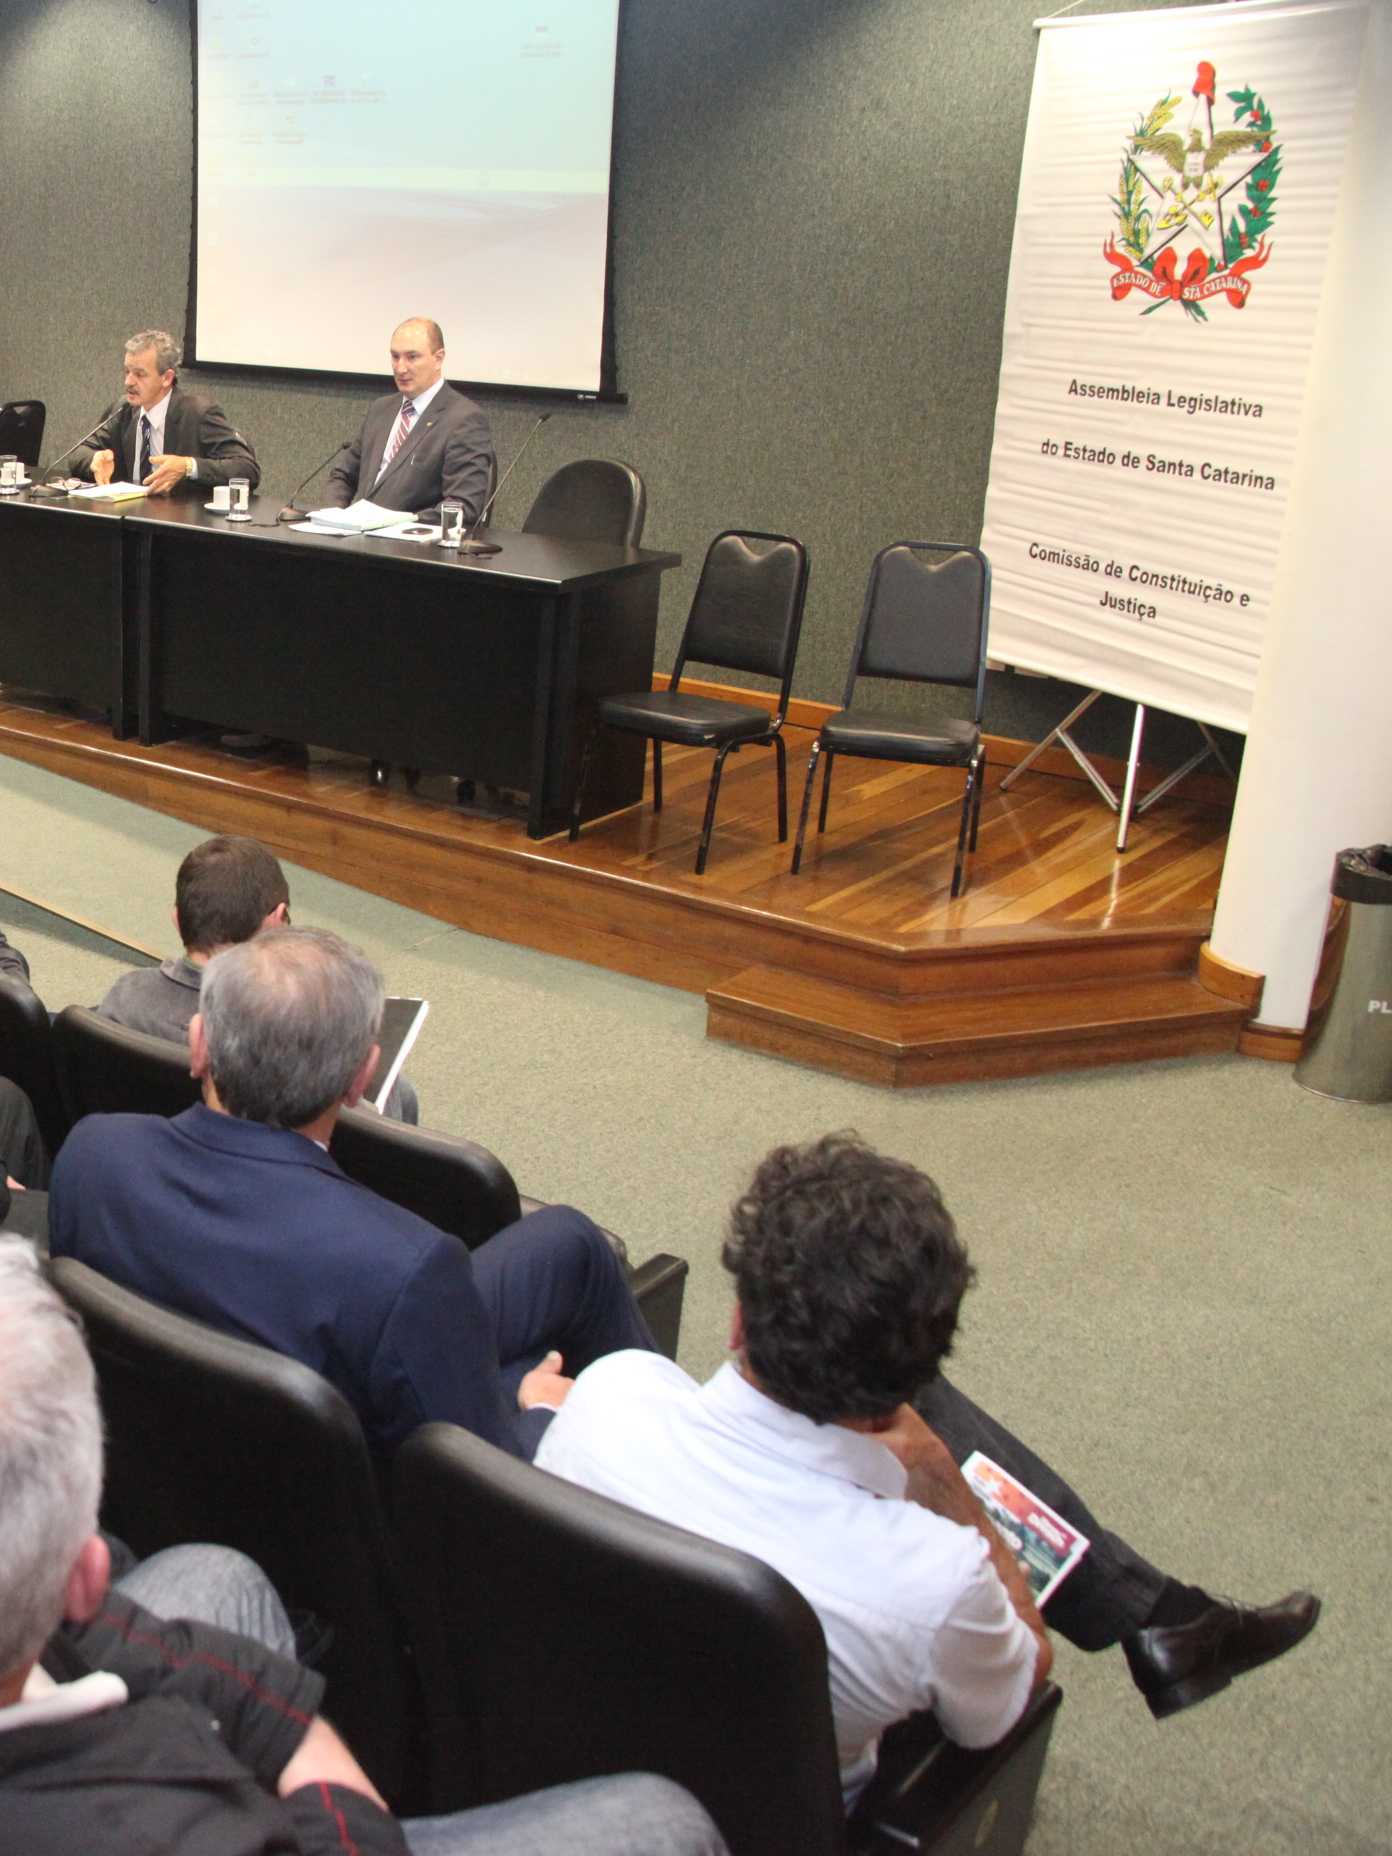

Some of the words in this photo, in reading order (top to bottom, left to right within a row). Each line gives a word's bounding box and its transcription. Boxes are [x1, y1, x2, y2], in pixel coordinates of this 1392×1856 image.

[1113, 272, 1149, 287] ESTADO
[1149, 282, 1163, 296] DE
[1203, 276, 1248, 294] CATARINA
[1068, 379, 1161, 405] Assembleia
[1166, 390, 1263, 418] Legislativa
[1041, 438, 1058, 456] do
[1063, 441, 1116, 465] Estado
[1121, 451, 1140, 469] de
[1145, 454, 1194, 478] Santa
[1200, 462, 1275, 491] Catarina
[1028, 542, 1100, 573] Comissão
[1104, 560, 1123, 578] de
[1128, 565, 1234, 604] Constituição
[1239, 590, 1251, 607] e
[1099, 591, 1157, 621] Justiça
